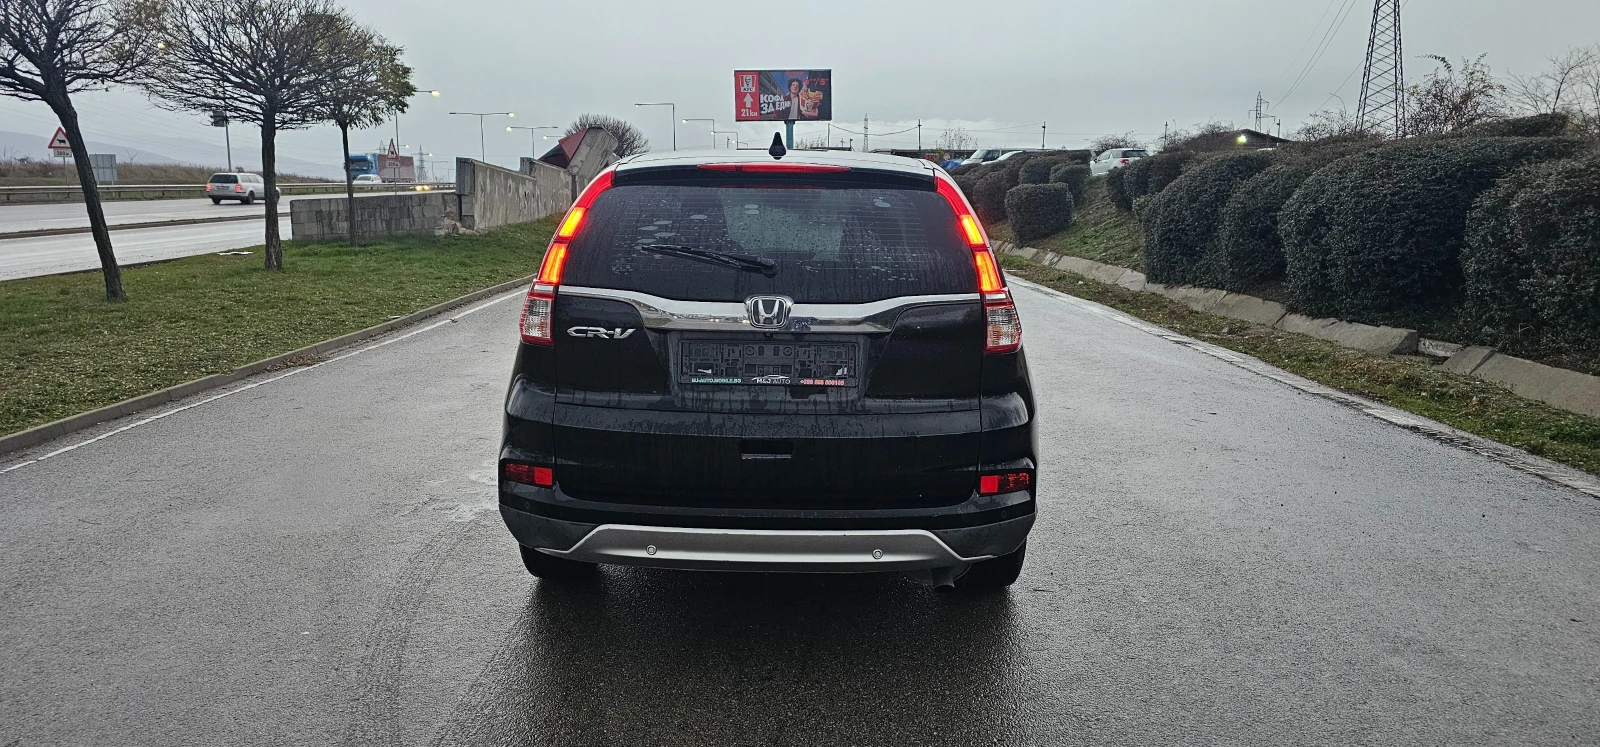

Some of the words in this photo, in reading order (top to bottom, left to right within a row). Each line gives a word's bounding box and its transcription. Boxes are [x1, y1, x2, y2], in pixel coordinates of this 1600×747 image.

[760, 94, 784, 103] КОФА
[741, 108, 749, 116] 21
[760, 103, 774, 114] ЗА
[567, 326, 636, 339] CR-V
